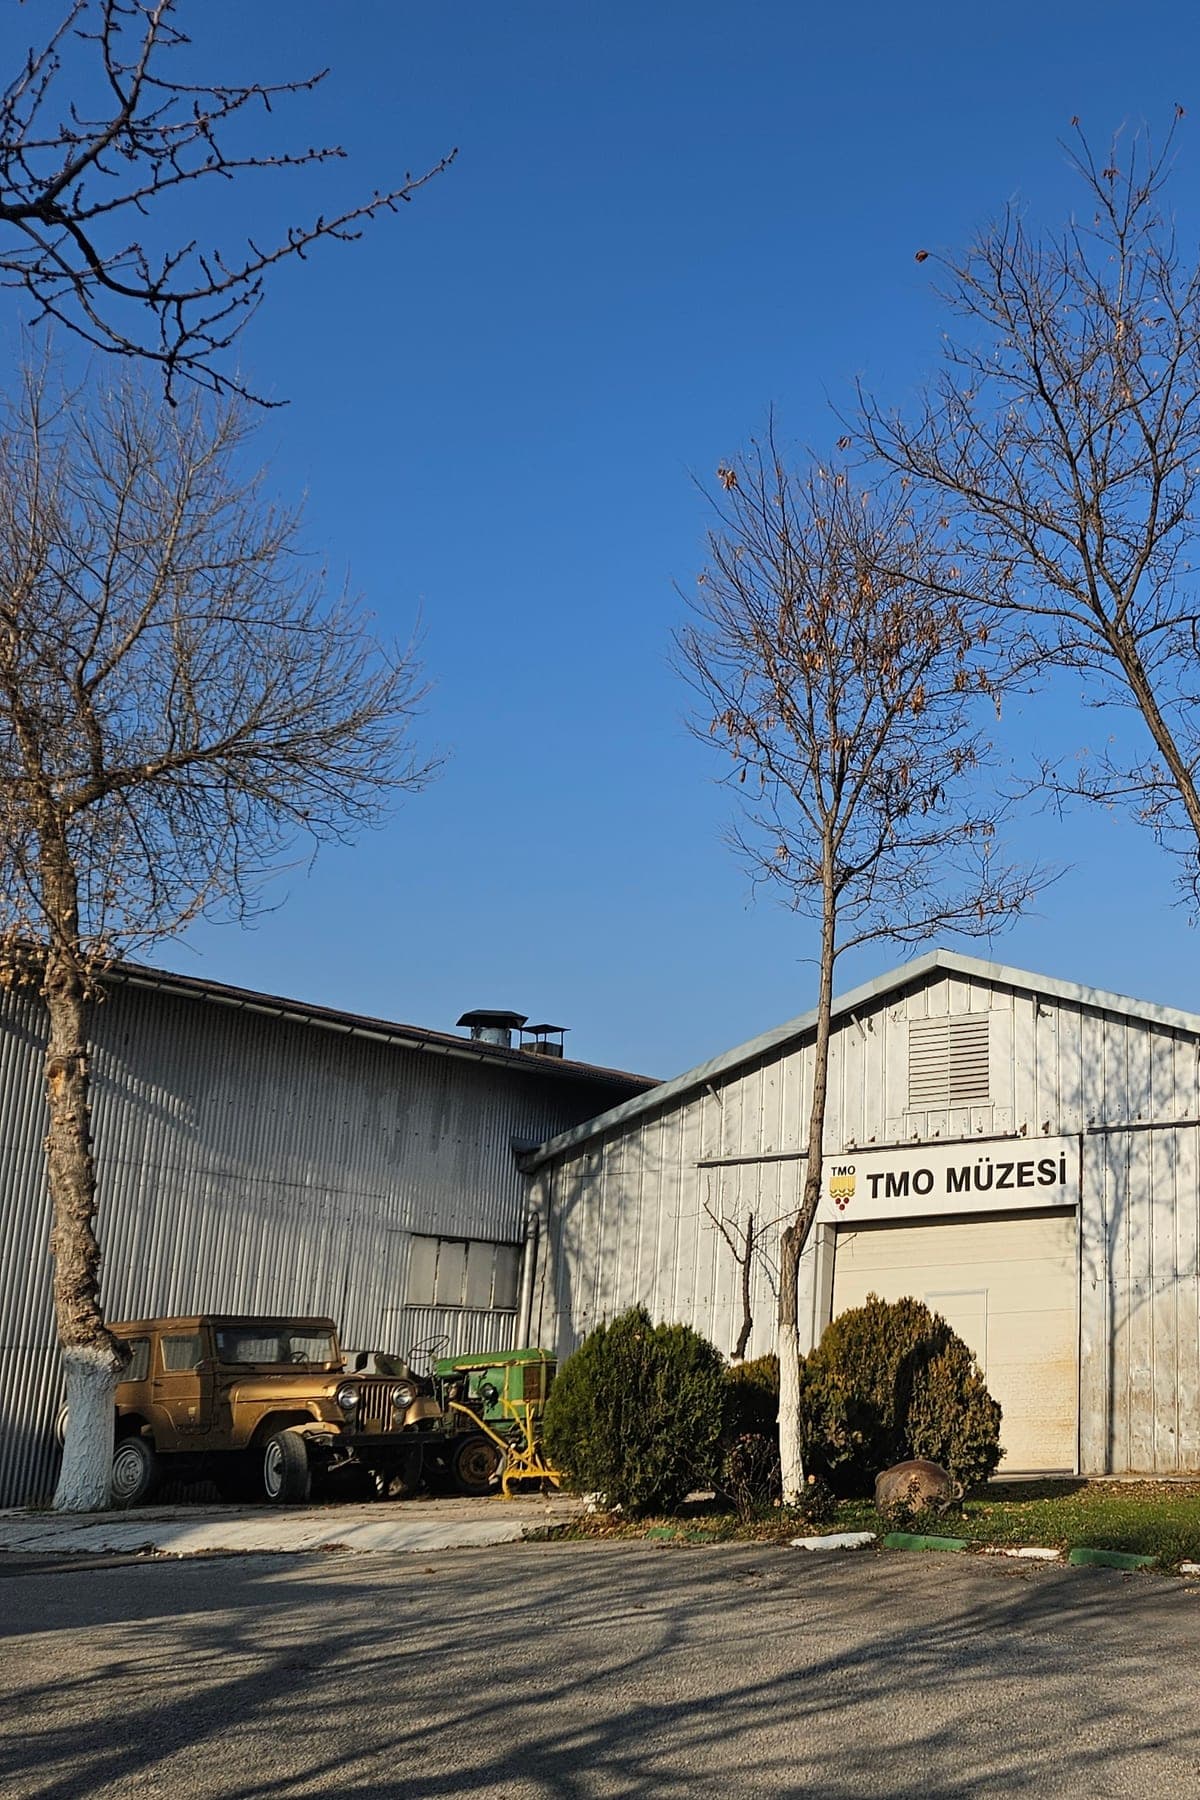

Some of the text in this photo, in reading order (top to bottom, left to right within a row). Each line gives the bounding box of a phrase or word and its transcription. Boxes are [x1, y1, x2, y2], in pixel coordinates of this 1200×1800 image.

[831, 1165, 856, 1176] TMO
[866, 1151, 1067, 1199] TMO MÜZESİ
